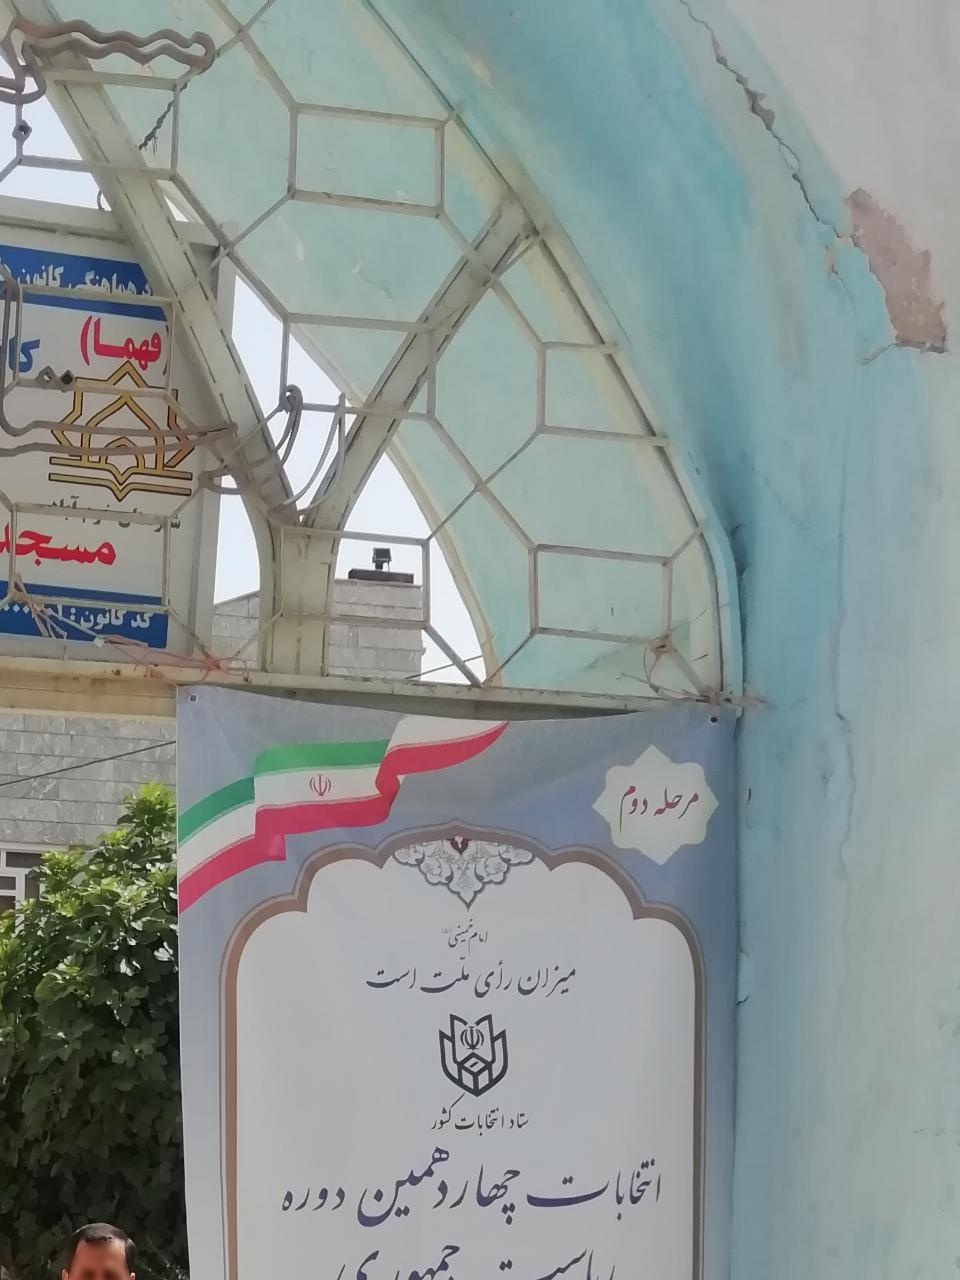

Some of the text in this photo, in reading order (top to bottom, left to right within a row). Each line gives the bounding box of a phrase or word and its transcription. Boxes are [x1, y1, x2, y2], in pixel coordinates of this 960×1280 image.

[130, 611, 153, 629] کد
[618, 785, 700, 834] مرحله دوم
[447, 918, 473, 948] خمینی
[468, 931, 489, 955] امام
[365, 967, 417, 989] است
[474, 959, 513, 998] رأی
[517, 964, 577, 998] میزان
[430, 1091, 530, 1136] ستاد انتخابات کشور
[280, 1145, 662, 1228] انتخابات چهاردهمین دوره
